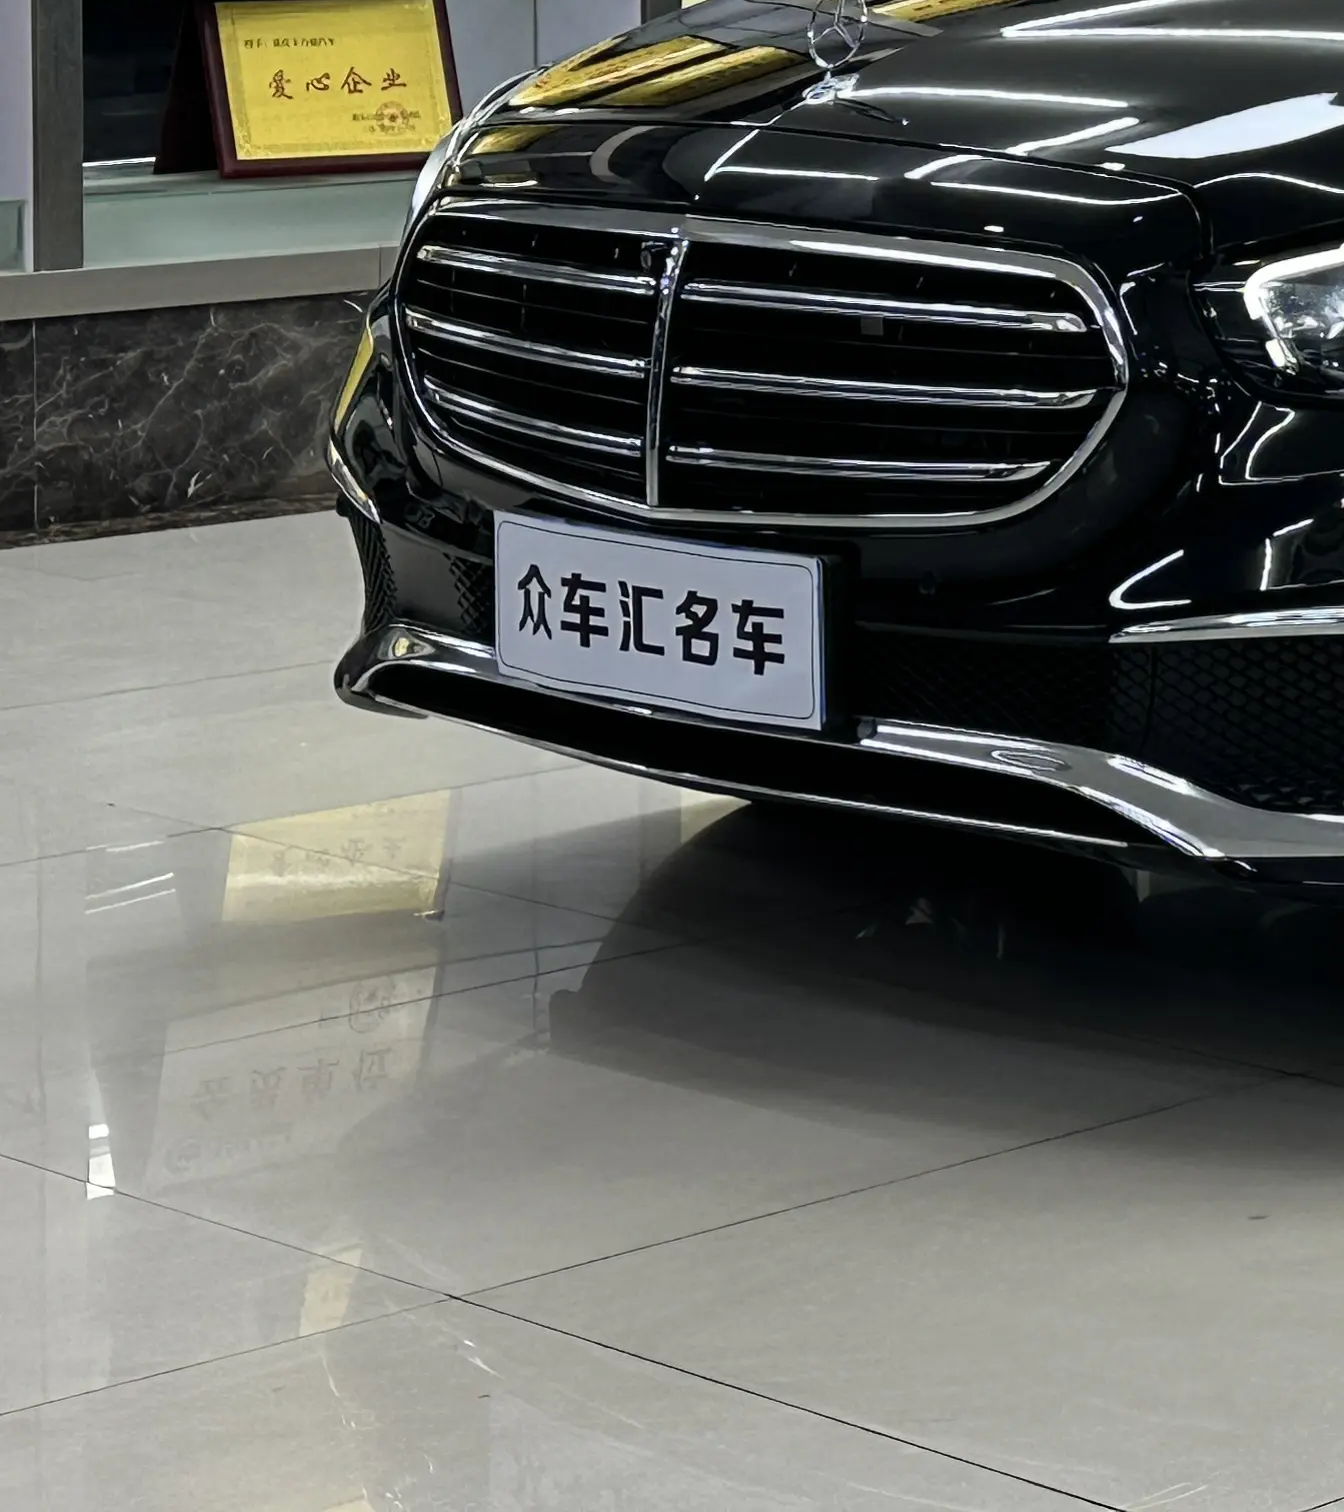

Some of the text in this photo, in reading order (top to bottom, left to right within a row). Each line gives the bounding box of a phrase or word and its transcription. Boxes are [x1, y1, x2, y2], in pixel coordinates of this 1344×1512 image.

[517, 564, 785, 676] 众车汇名车
